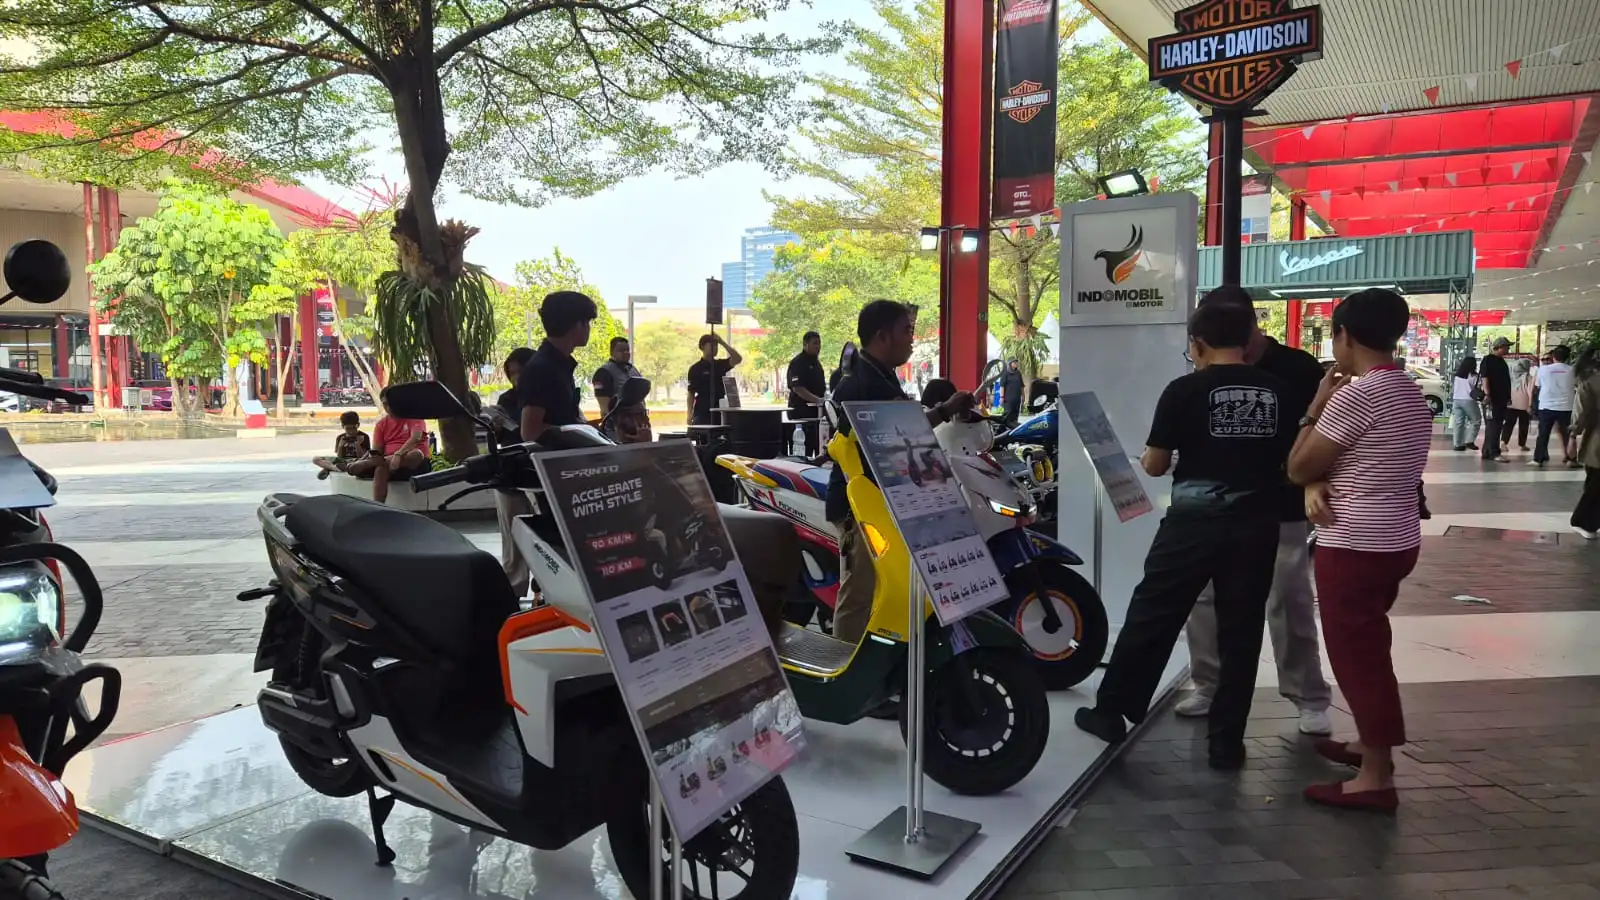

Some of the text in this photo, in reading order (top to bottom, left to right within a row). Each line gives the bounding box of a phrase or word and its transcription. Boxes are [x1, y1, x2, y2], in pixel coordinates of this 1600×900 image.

[1193, 0, 1271, 30] MOTOR
[1160, 18, 1308, 70] HARLEY-DAVIDSON
[1012, 83, 1038, 95] MOTOR
[1193, 61, 1272, 98] CYCLES
[1011, 106, 1037, 120] CYCLES
[1279, 245, 1364, 276] Vespa
[1077, 288, 1164, 302] INDOMOBIL
[560, 464, 619, 479] SPRINTO
[571, 477, 643, 505] ACCELERATE
[572, 490, 643, 518] WITH STYLE
[591, 539, 606, 550] 90
[607, 533, 632, 546] KM/H
[617, 560, 633, 573] KM
